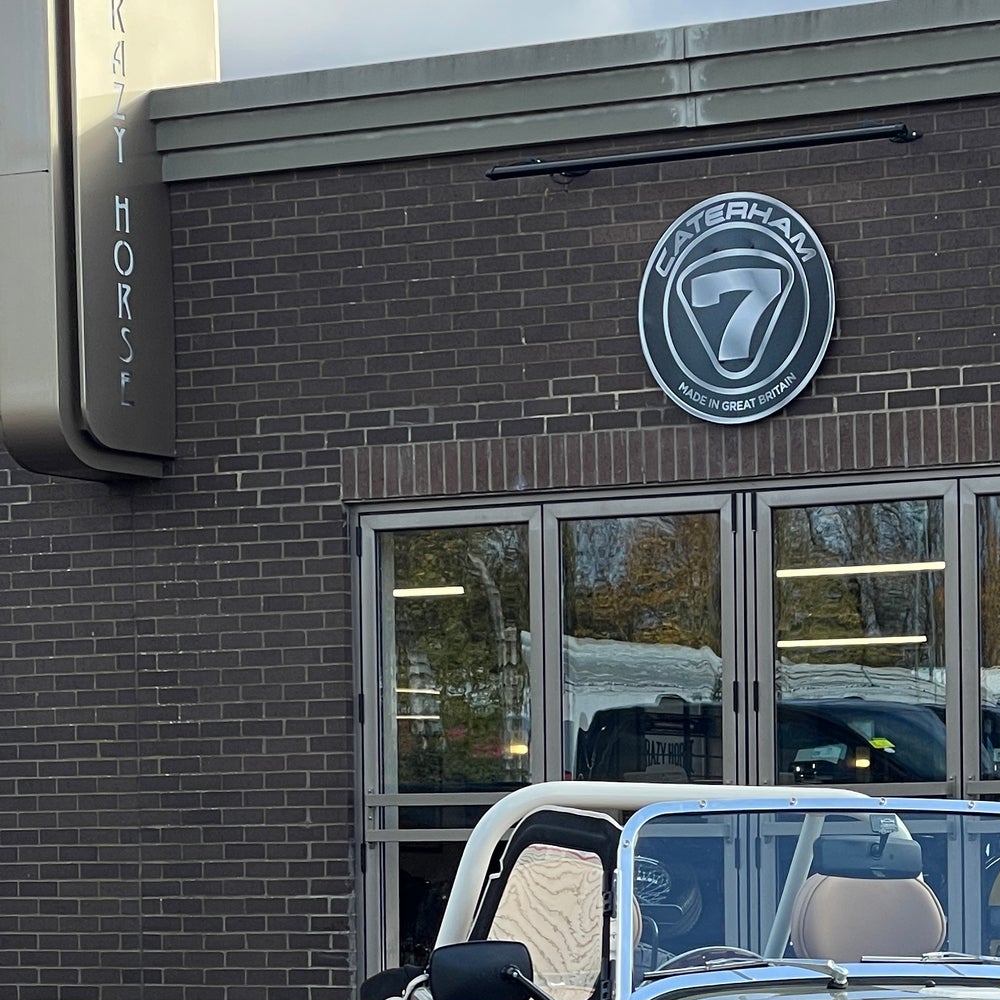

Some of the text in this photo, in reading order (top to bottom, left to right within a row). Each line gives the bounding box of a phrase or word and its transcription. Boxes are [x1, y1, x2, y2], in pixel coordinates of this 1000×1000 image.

[655, 201, 817, 278] CATERHAM
[113, 194, 135, 407] HORSE
[691, 267, 782, 361] 7
[678, 372, 797, 412] MADE IN GREAT BRITAIN
